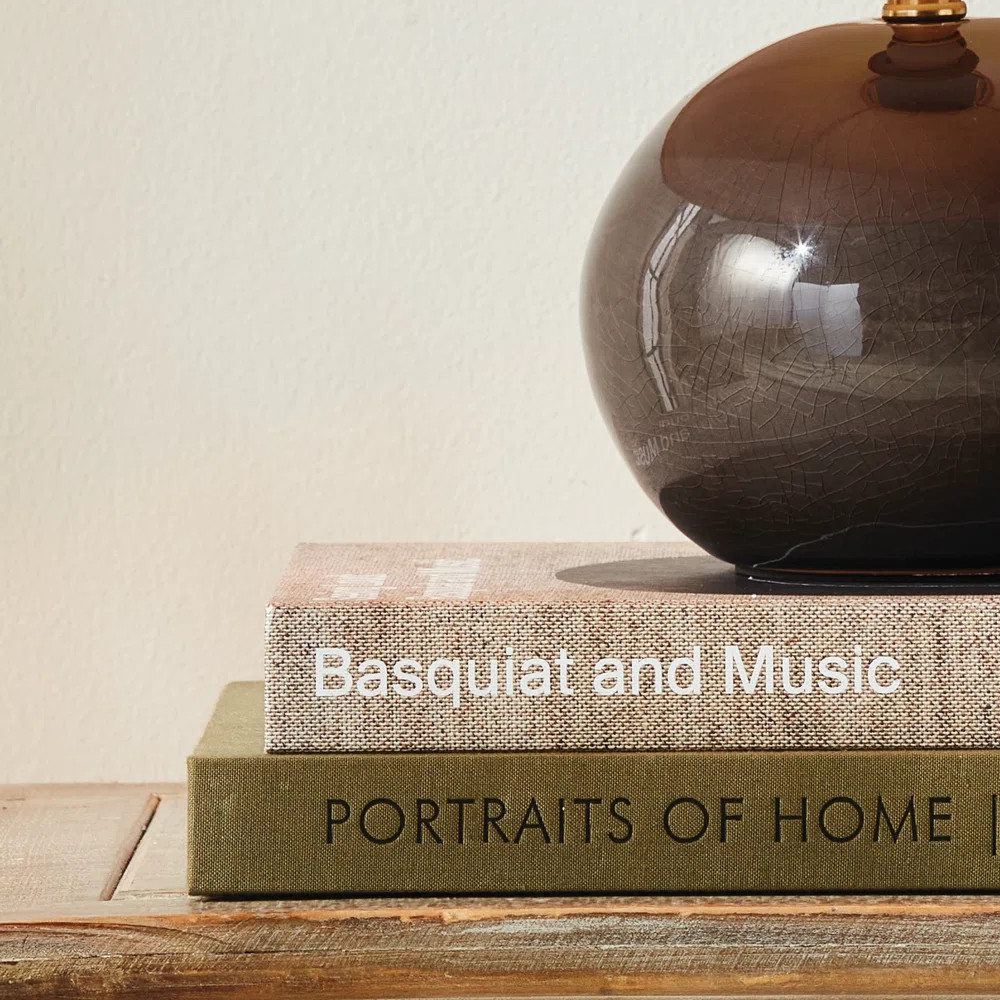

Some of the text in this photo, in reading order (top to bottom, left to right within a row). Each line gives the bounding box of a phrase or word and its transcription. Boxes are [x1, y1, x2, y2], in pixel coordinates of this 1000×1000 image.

[315, 645, 901, 708] Basquiat and Music
[326, 797, 634, 845] PORTRAITS
[663, 796, 745, 844] OF
[774, 795, 953, 843] HOME
